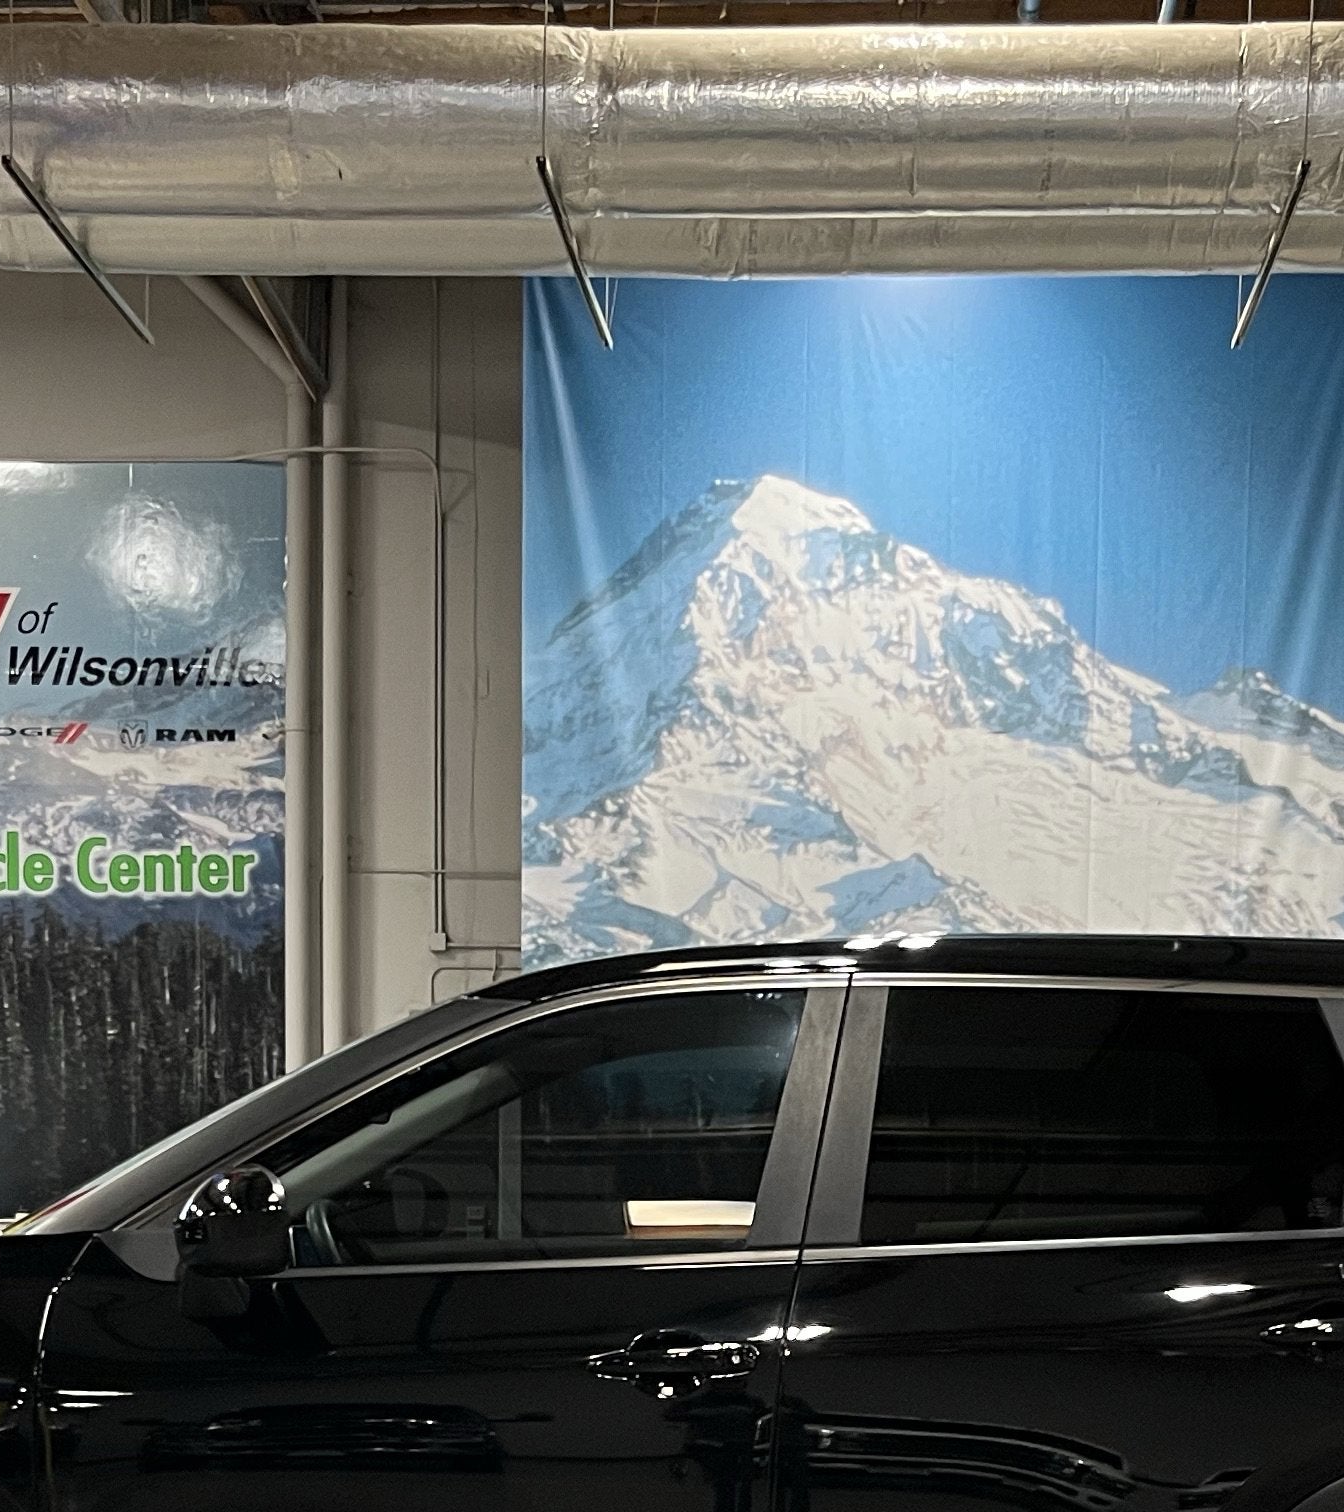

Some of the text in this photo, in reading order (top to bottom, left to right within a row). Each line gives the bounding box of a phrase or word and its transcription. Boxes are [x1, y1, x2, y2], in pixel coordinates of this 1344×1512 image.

[17, 602, 59, 635] of
[156, 728, 237, 743] RAM
[76, 837, 256, 894] Center
